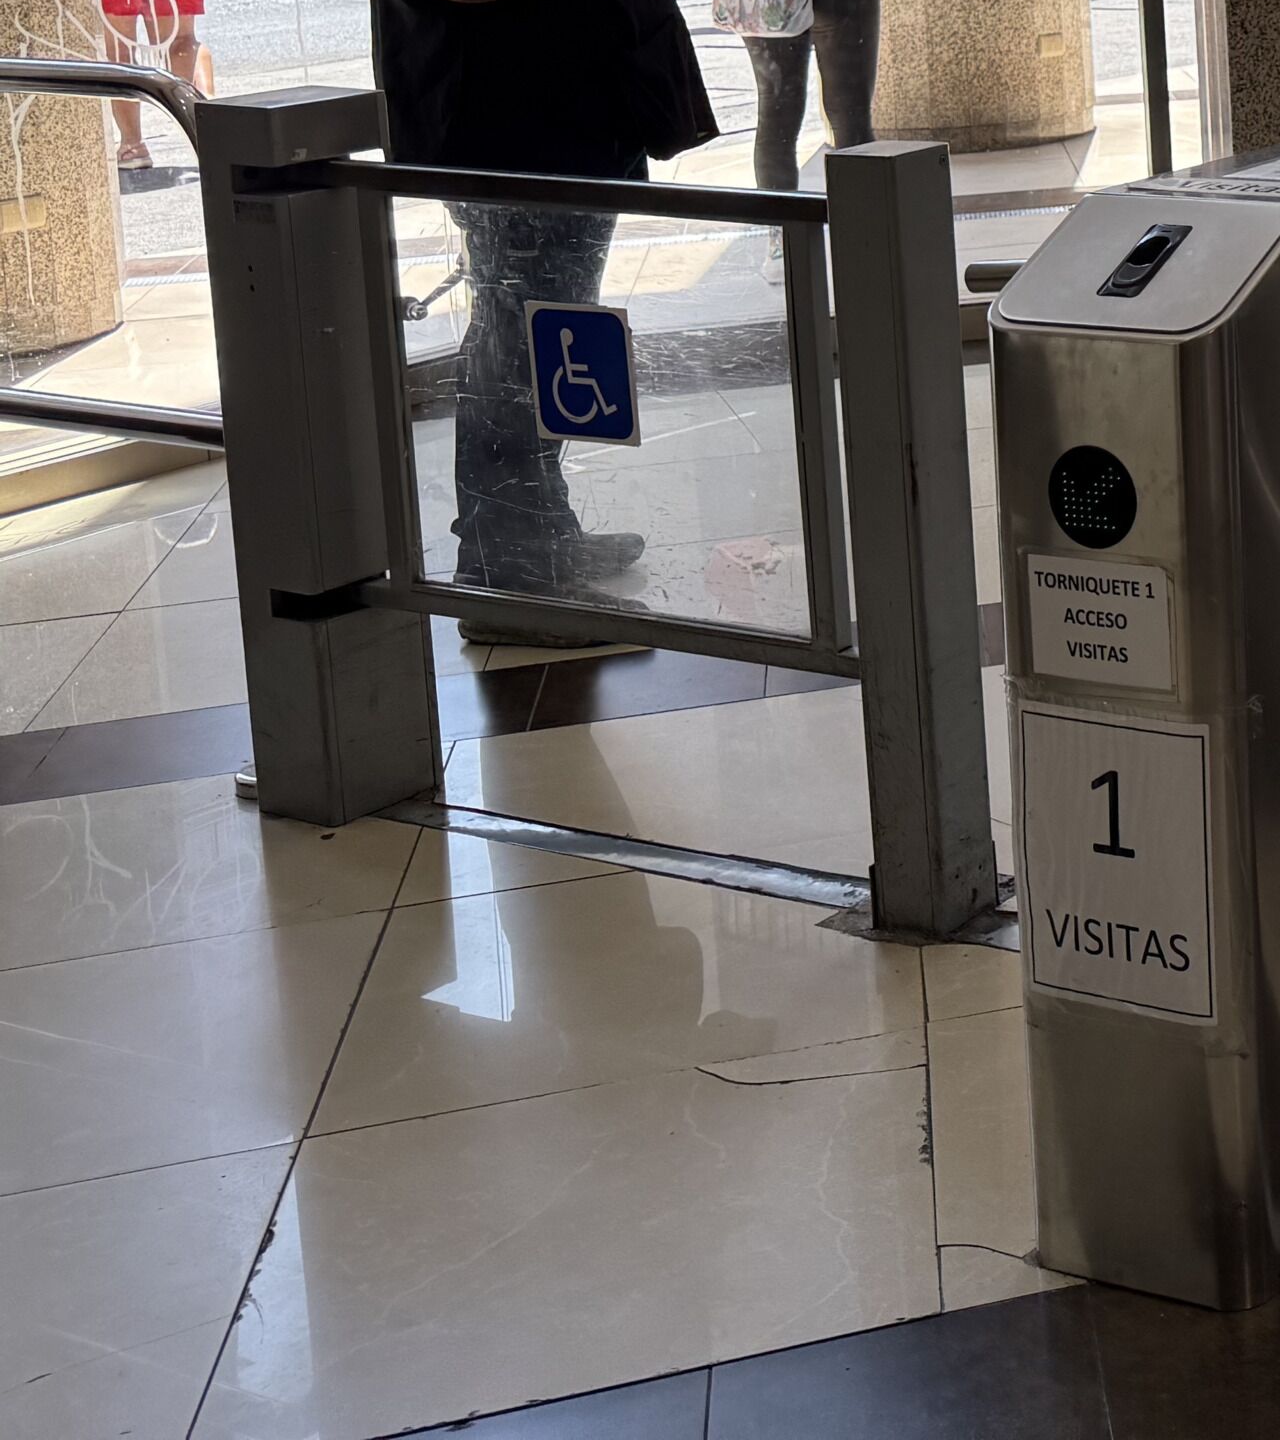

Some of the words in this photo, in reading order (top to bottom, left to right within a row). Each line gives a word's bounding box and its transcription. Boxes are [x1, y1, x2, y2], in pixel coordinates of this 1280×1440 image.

[1034, 570, 1140, 599] TORNIQUETE
[1144, 582, 1155, 599] 1
[1063, 607, 1128, 631] ACCESO
[1066, 640, 1129, 664] VISITAS
[1090, 769, 1136, 859] 1
[1046, 907, 1191, 973] VISITAS
